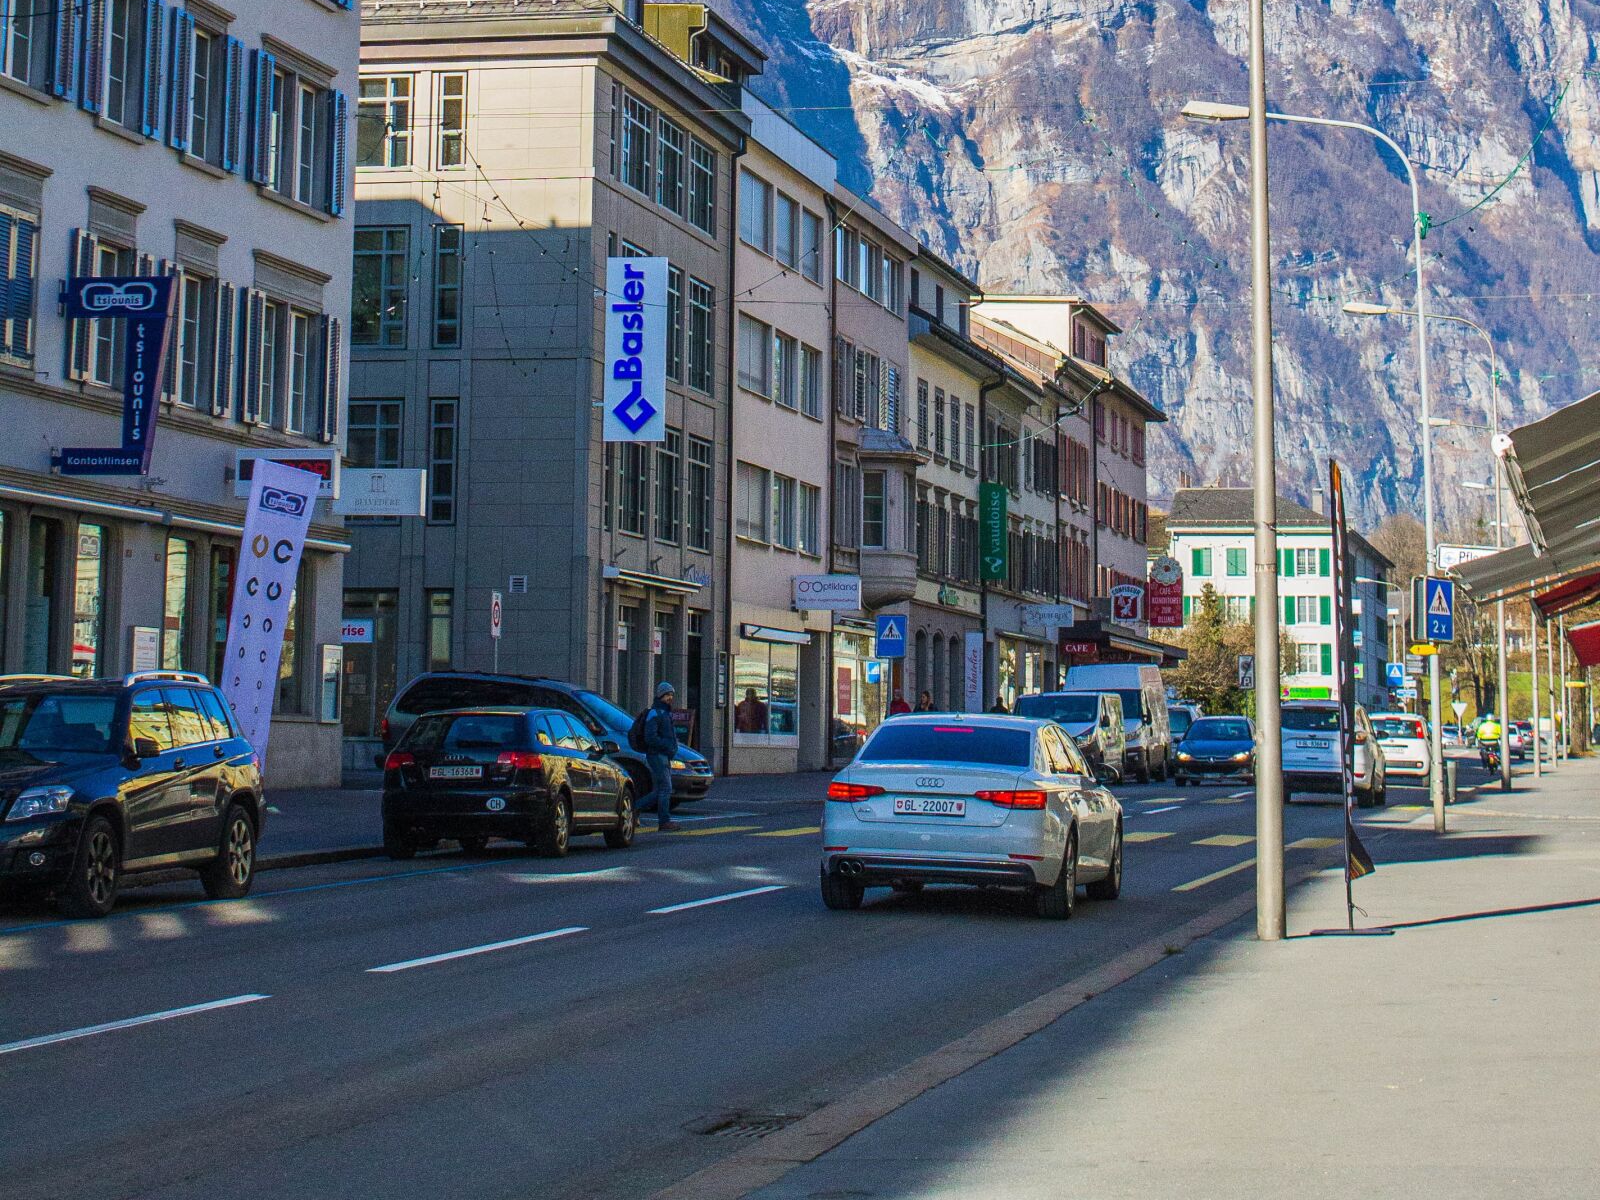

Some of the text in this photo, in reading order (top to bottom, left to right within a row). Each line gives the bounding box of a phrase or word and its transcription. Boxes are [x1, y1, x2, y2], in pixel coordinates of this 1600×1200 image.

[96, 294, 142, 305] tsiounis
[612, 263, 645, 380] Basler
[132, 323, 145, 440] tsiounis
[67, 455, 139, 466] Kontaktlinsen
[987, 491, 1001, 554] vaudoise
[1433, 620, 1439, 633] 2
[490, 799, 501, 809] CH
